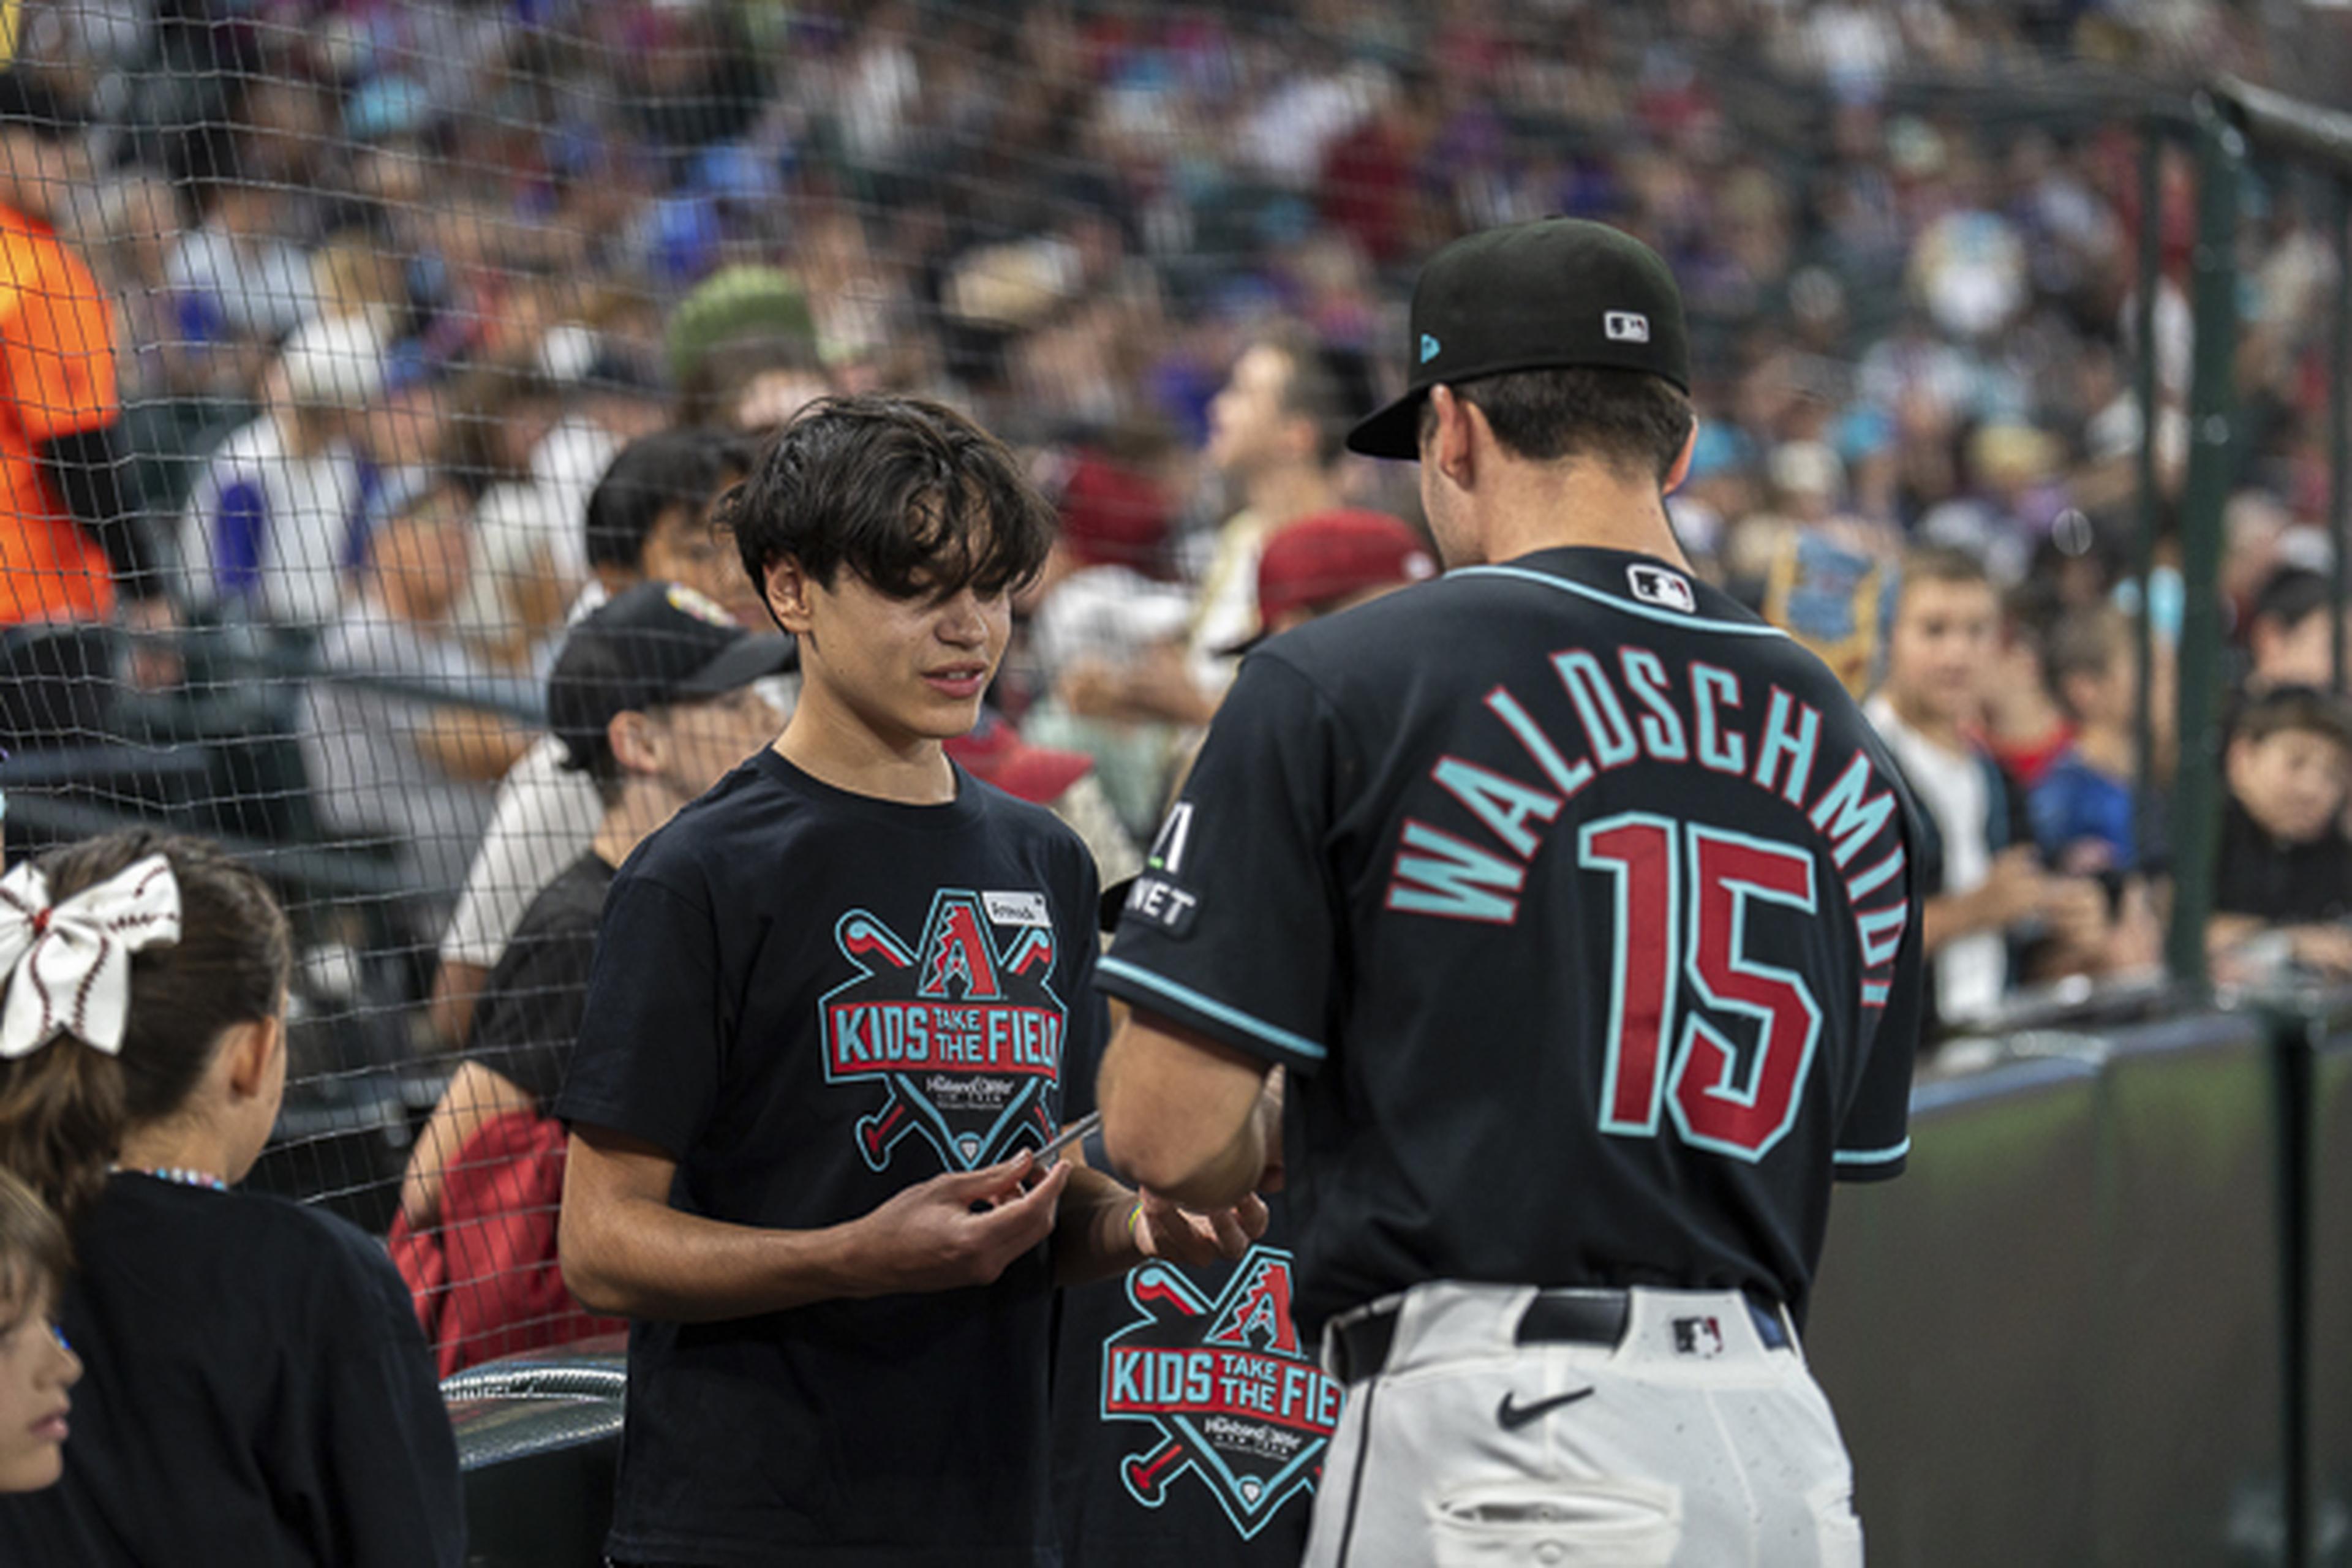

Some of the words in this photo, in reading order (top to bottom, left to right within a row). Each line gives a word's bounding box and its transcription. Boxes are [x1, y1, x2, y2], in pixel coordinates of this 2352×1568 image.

[1578, 812, 1823, 1163] 15
[835, 1005, 928, 1063] KIDS
[933, 1006, 981, 1031] TAKE
[933, 1031, 982, 1062] THE
[1112, 1350, 1213, 1403] KIDS
[1219, 1354, 1278, 1383] TAKE
[1219, 1378, 1276, 1413] THE
